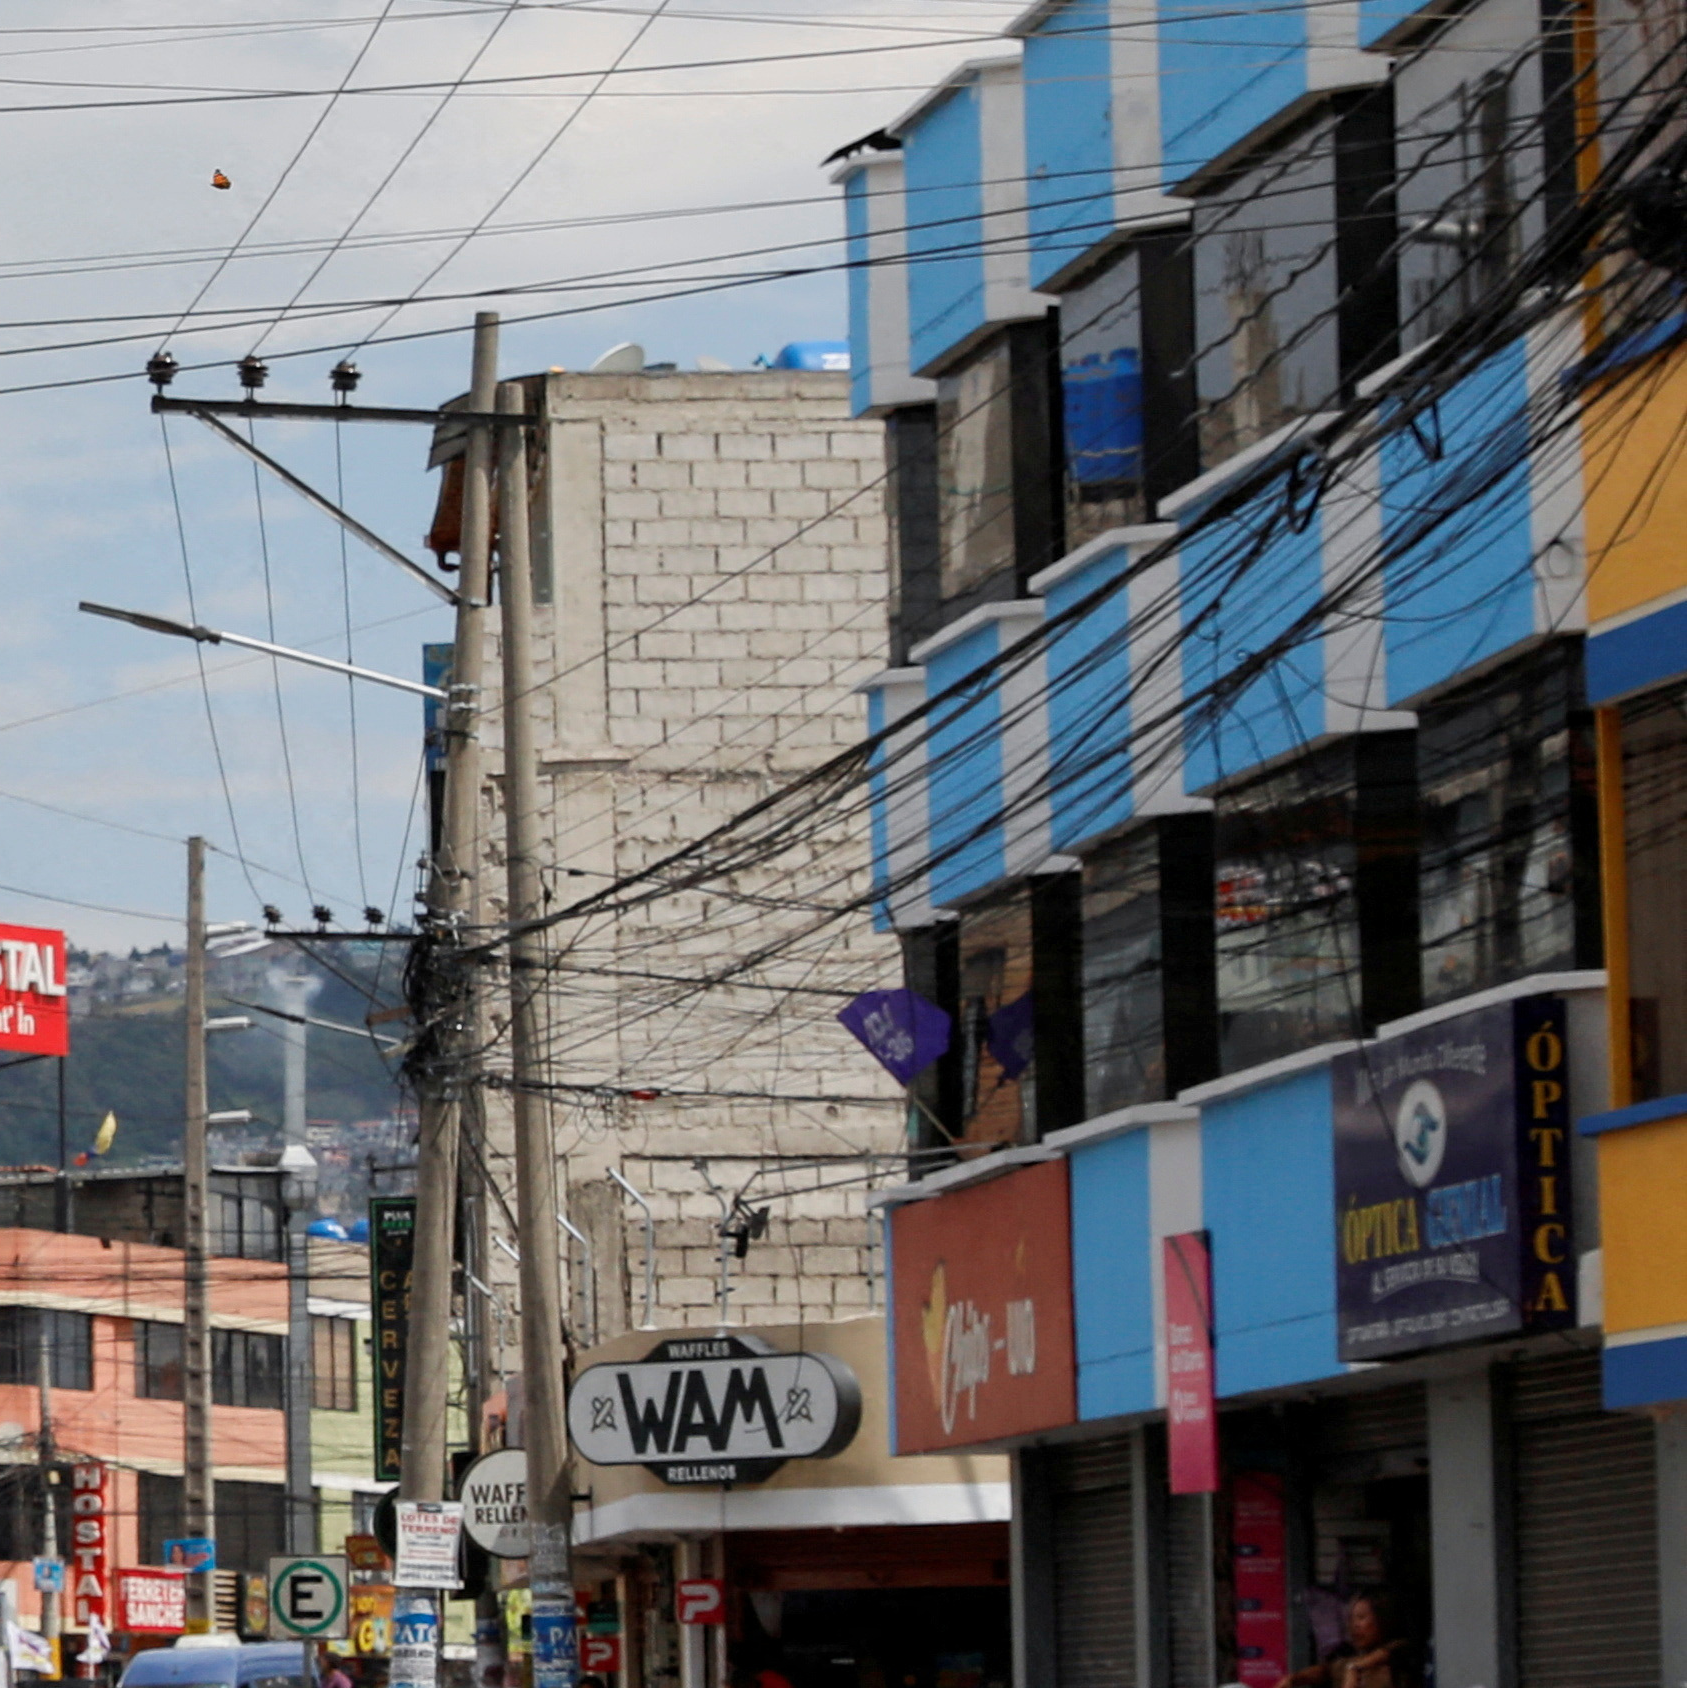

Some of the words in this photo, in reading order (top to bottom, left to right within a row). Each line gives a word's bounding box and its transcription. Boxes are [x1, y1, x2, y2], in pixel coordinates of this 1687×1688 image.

[1526, 1020, 1569, 1312] ÓPTICA
[668, 1341, 730, 1357] WAFFLES
[379, 1270, 401, 1468] CERVEZA
[616, 1367, 785, 1455] WAM
[668, 1465, 736, 1482] RELLENOS
[470, 1483, 526, 1505] WAFF
[476, 1506, 529, 1525] RELLEN
[73, 1467, 102, 1624] HOSTAL
[290, 1575, 323, 1619] E
[127, 1602, 185, 1628] SANCHE
